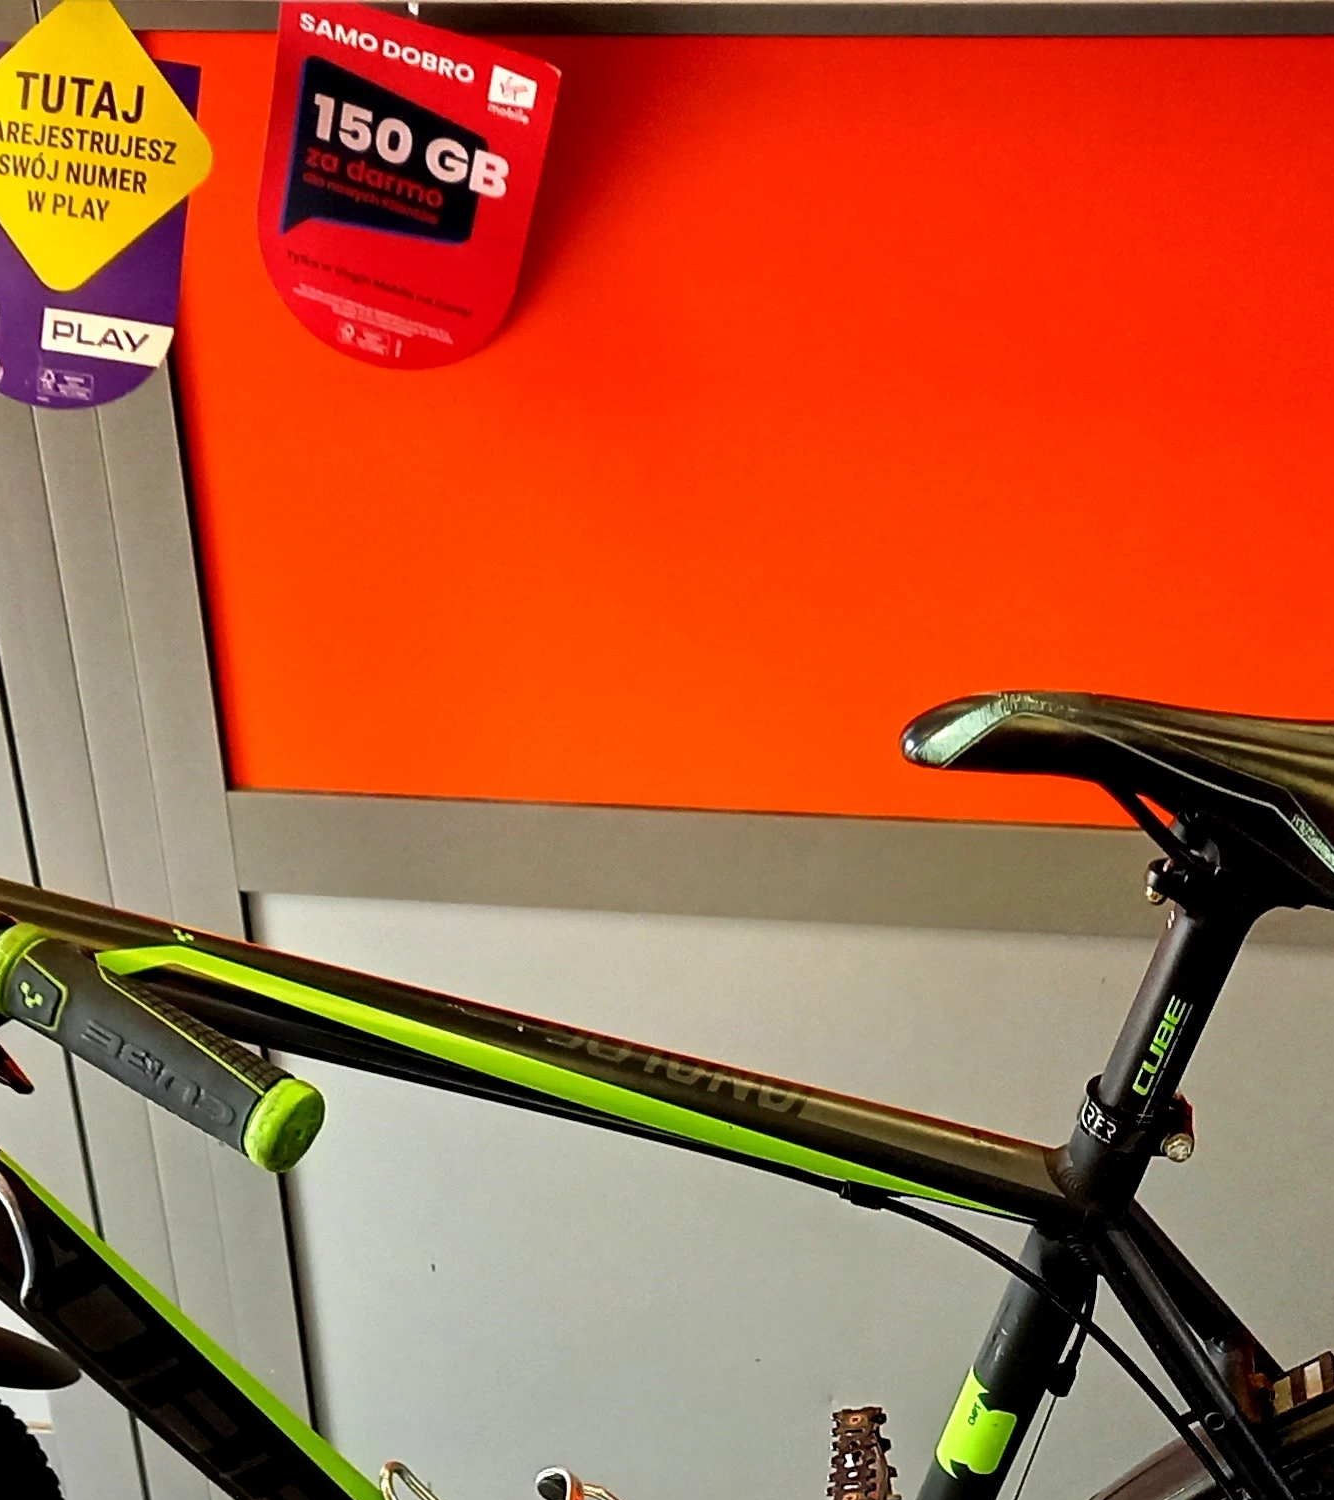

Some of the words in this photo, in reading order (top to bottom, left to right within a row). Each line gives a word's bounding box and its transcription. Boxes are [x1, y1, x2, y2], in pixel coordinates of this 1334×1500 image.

[299, 12, 378, 52] SAMO
[382, 39, 475, 84] DOBRO
[15, 71, 145, 124] TUTAJ
[313, 93, 413, 164] 150
[425, 137, 510, 198] GB
[27, 190, 43, 213] W
[52, 194, 110, 222] PLAY
[66, 163, 147, 194] NUMER
[305, 147, 340, 174] za
[346, 160, 444, 209] darmo
[51, 321, 149, 353] PLAY
[80, 1018, 238, 1127] CUBE
[1132, 994, 1187, 1096] CUBE
